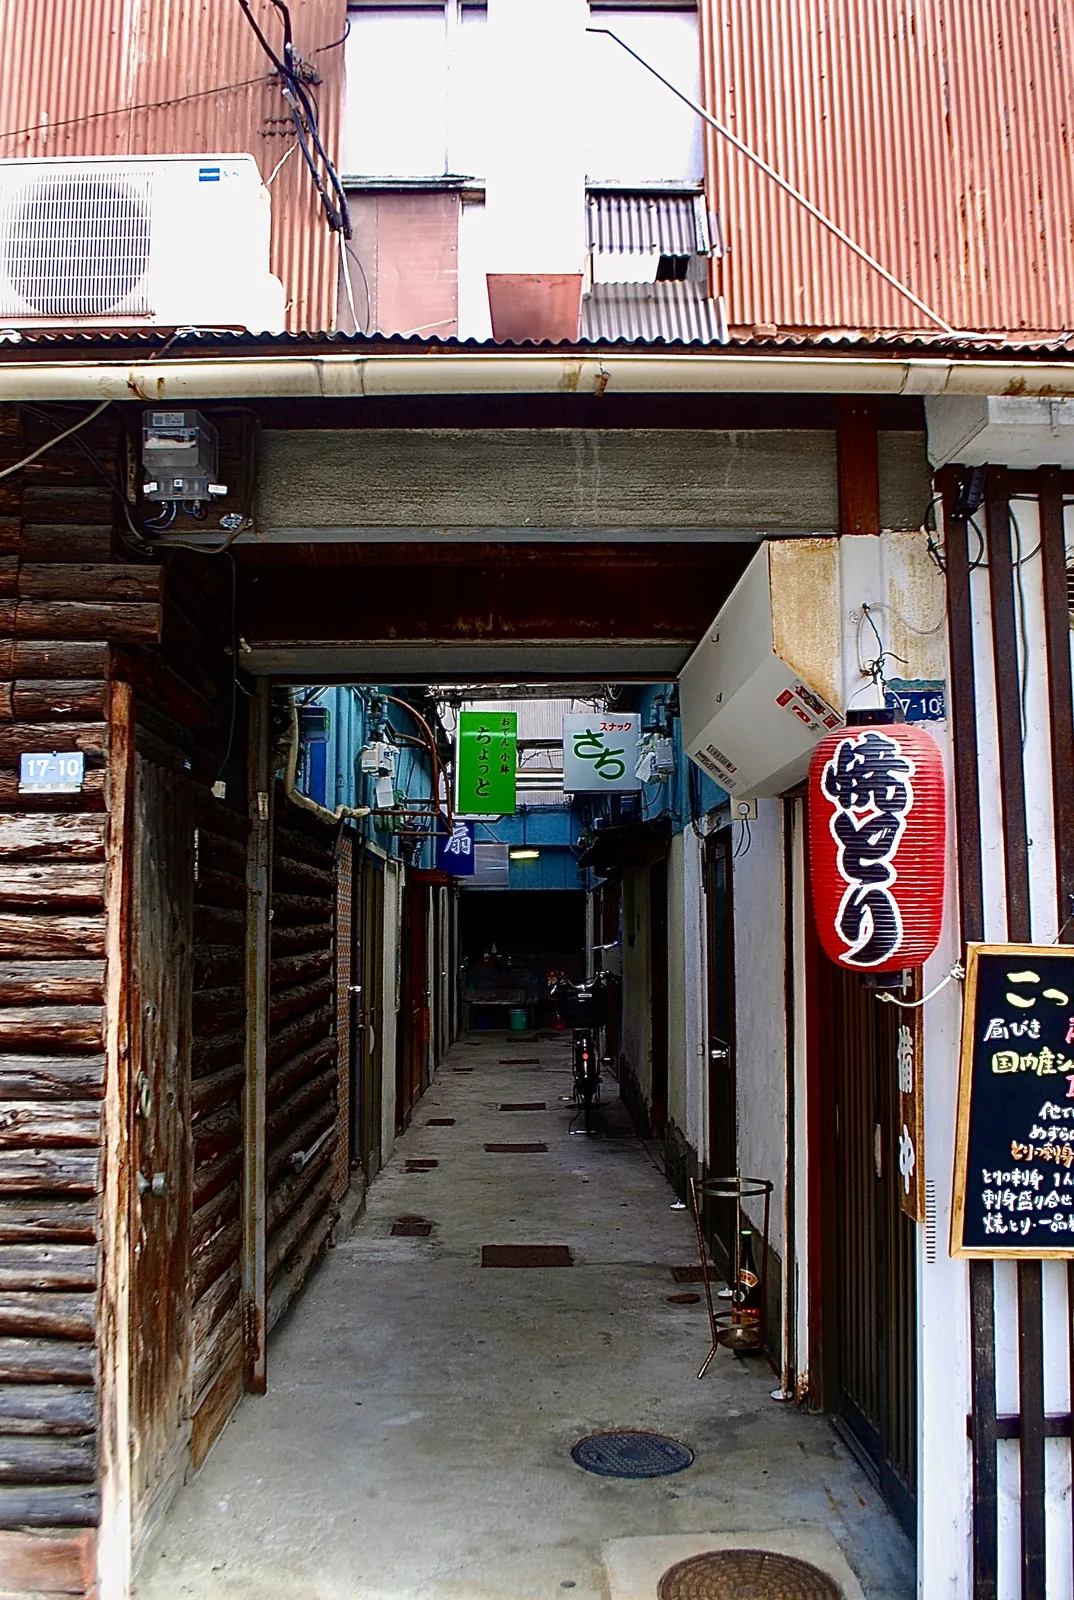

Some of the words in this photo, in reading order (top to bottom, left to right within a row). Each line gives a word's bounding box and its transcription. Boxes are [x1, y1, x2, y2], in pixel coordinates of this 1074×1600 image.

[600, 722, 632, 731] スナック
[475, 725, 492, 797] ちょっと
[572, 728, 626, 781] さち
[28, 759, 80, 777] 17-10
[822, 731, 914, 966] 焼とり
[991, 1046, 1074, 1076] 国内産シ
[982, 1168, 1044, 1191] とりの刺身
[981, 1189, 1073, 1212] 刺身盛り合せ
